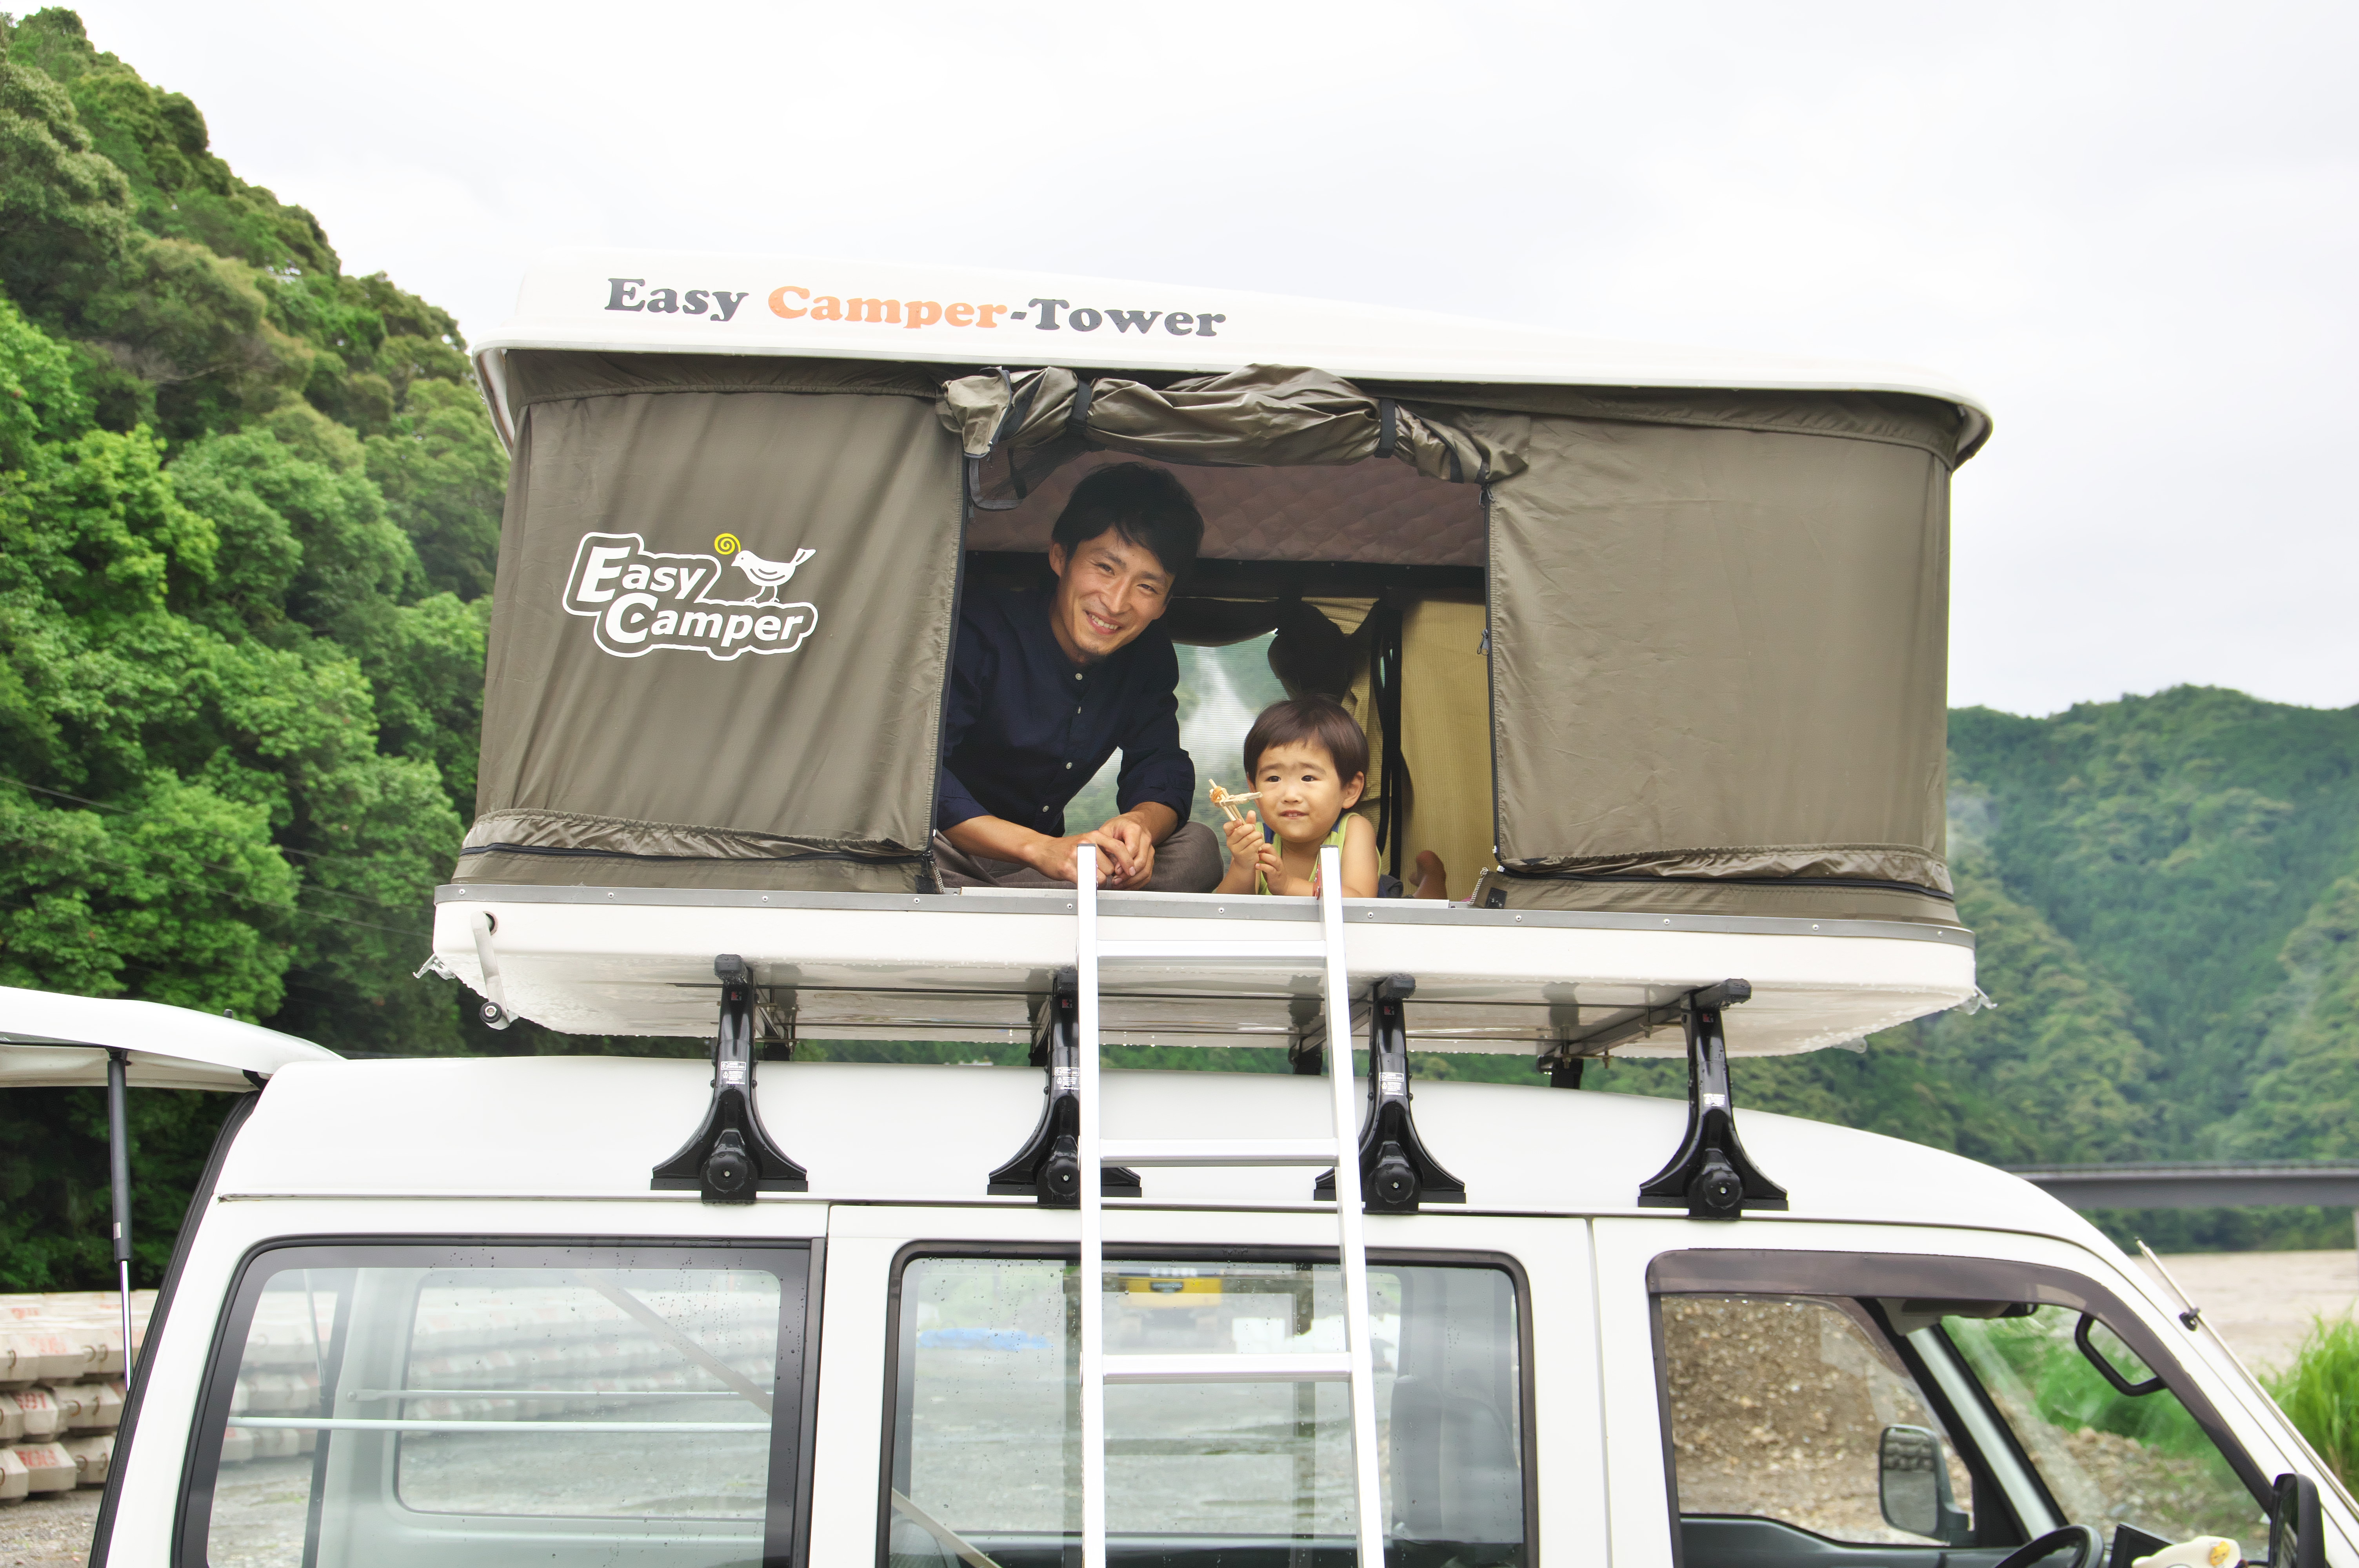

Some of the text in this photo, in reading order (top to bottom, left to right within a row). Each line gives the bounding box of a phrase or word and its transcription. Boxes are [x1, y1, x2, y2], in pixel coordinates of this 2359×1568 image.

[605, 278, 1226, 336] Easy Camper-Tower
[576, 546, 706, 602] Easy
[606, 593, 803, 647] Camper
